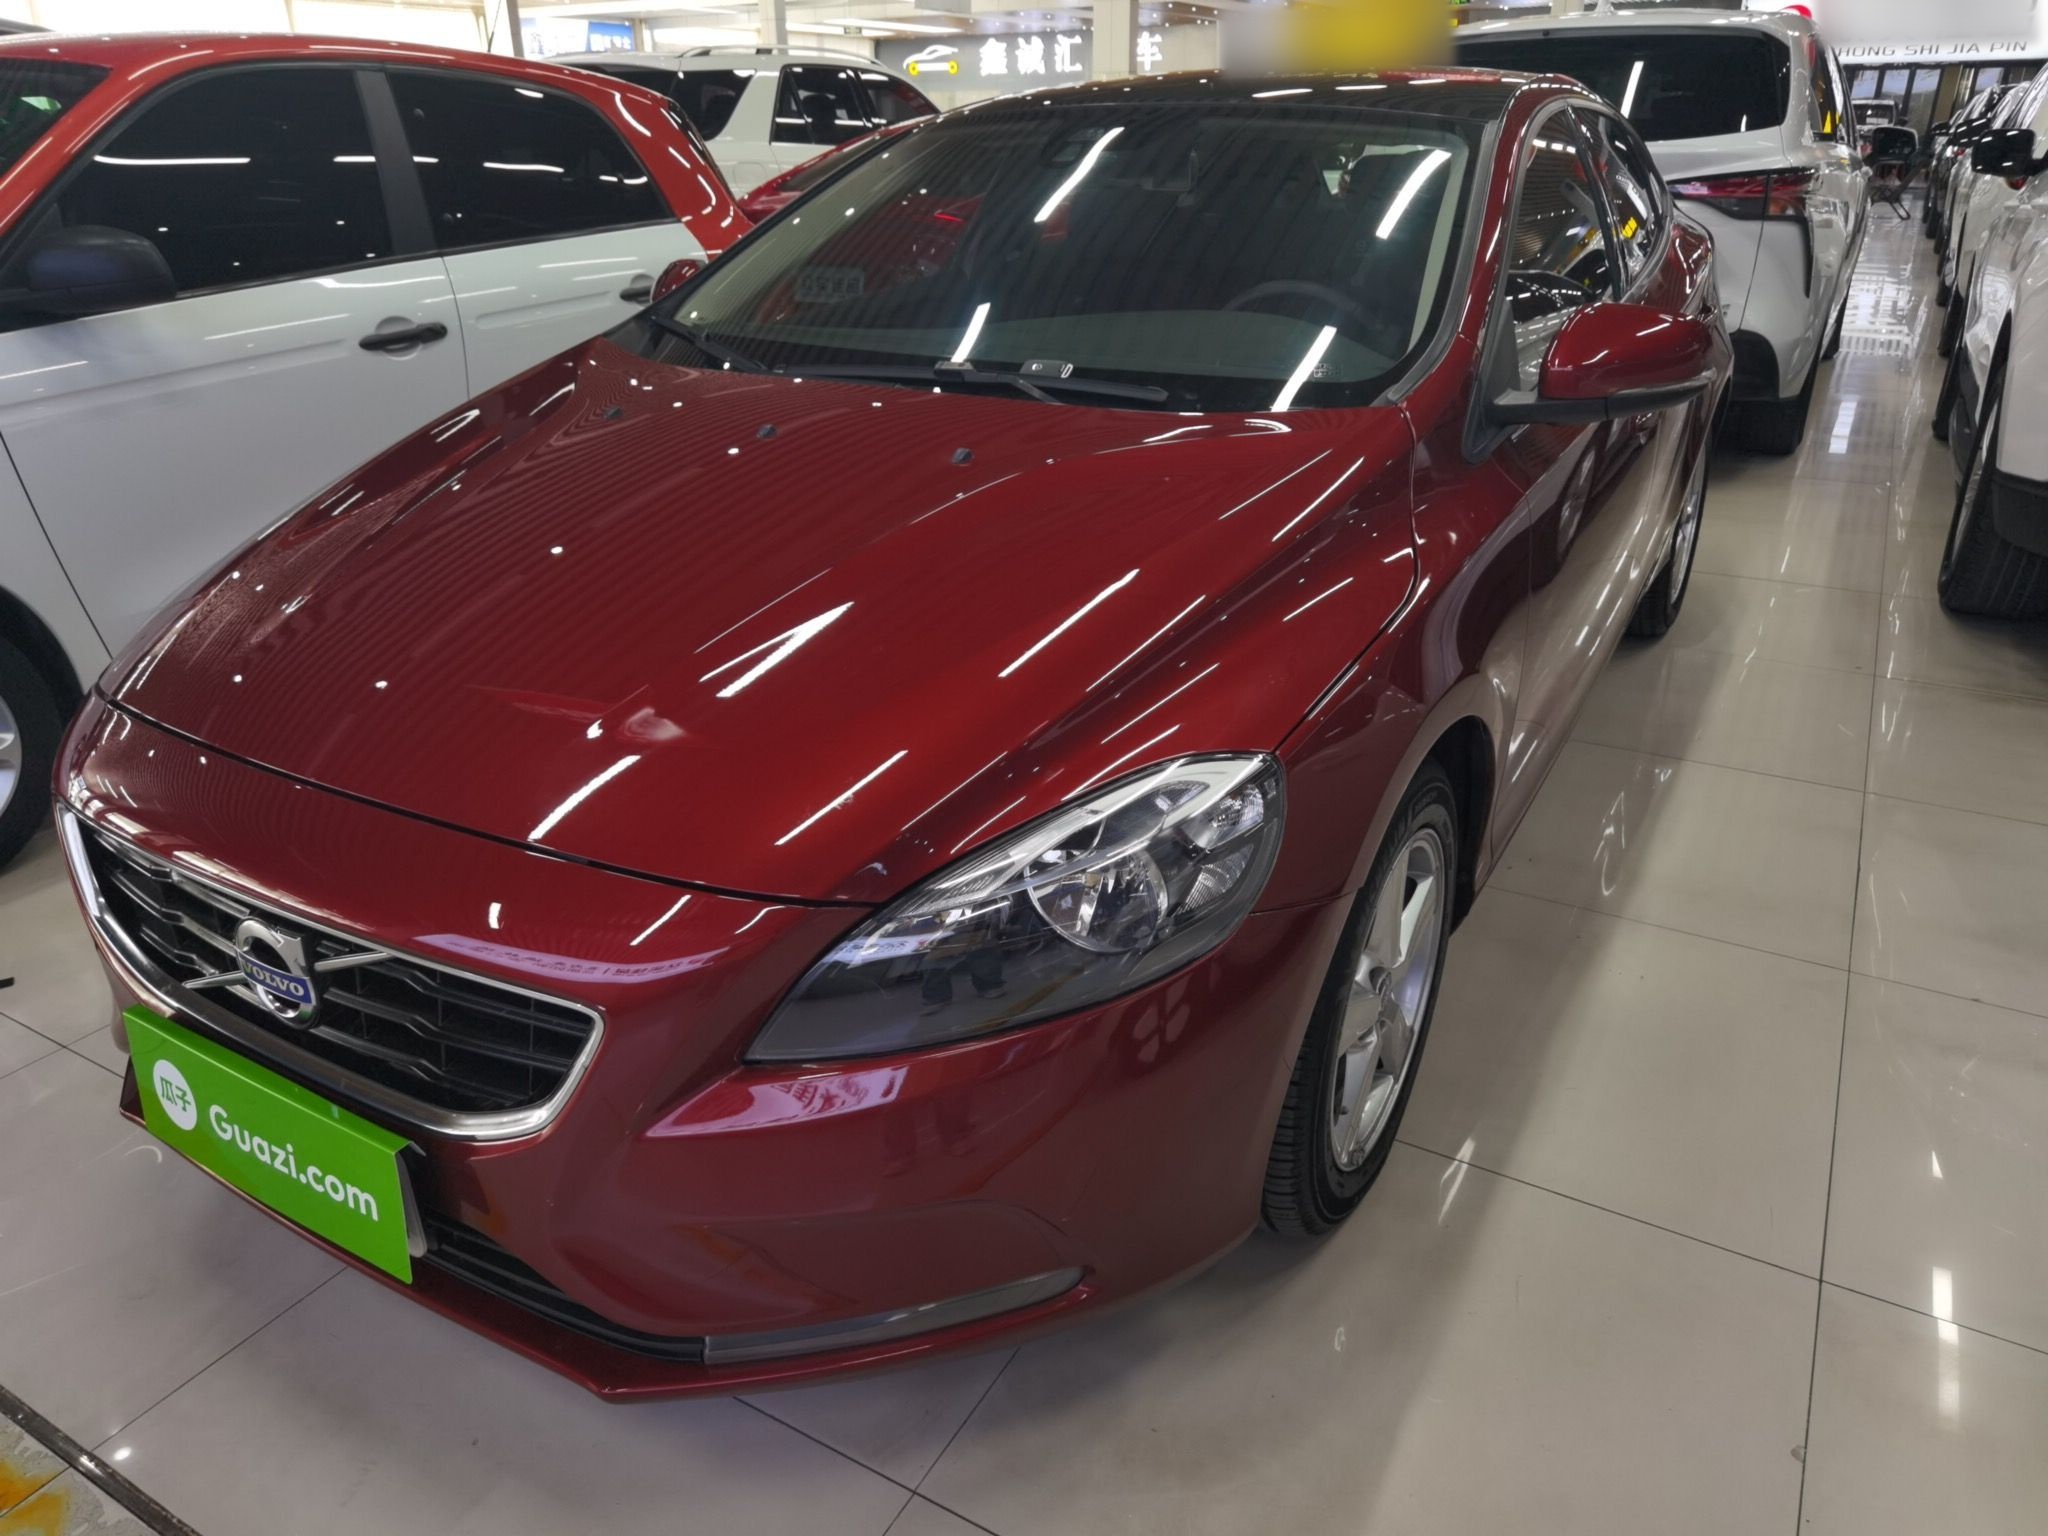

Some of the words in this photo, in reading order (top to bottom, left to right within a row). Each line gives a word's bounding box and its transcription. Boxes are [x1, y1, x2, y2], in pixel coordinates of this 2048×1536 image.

[1904, 44, 1940, 56] SHI
[1947, 43, 1980, 55] JIA
[1990, 41, 2028, 53] PIN
[242, 960, 305, 997] VOLVO
[160, 1075, 192, 1113] 瓜子
[209, 1104, 379, 1222] Guazi.com
